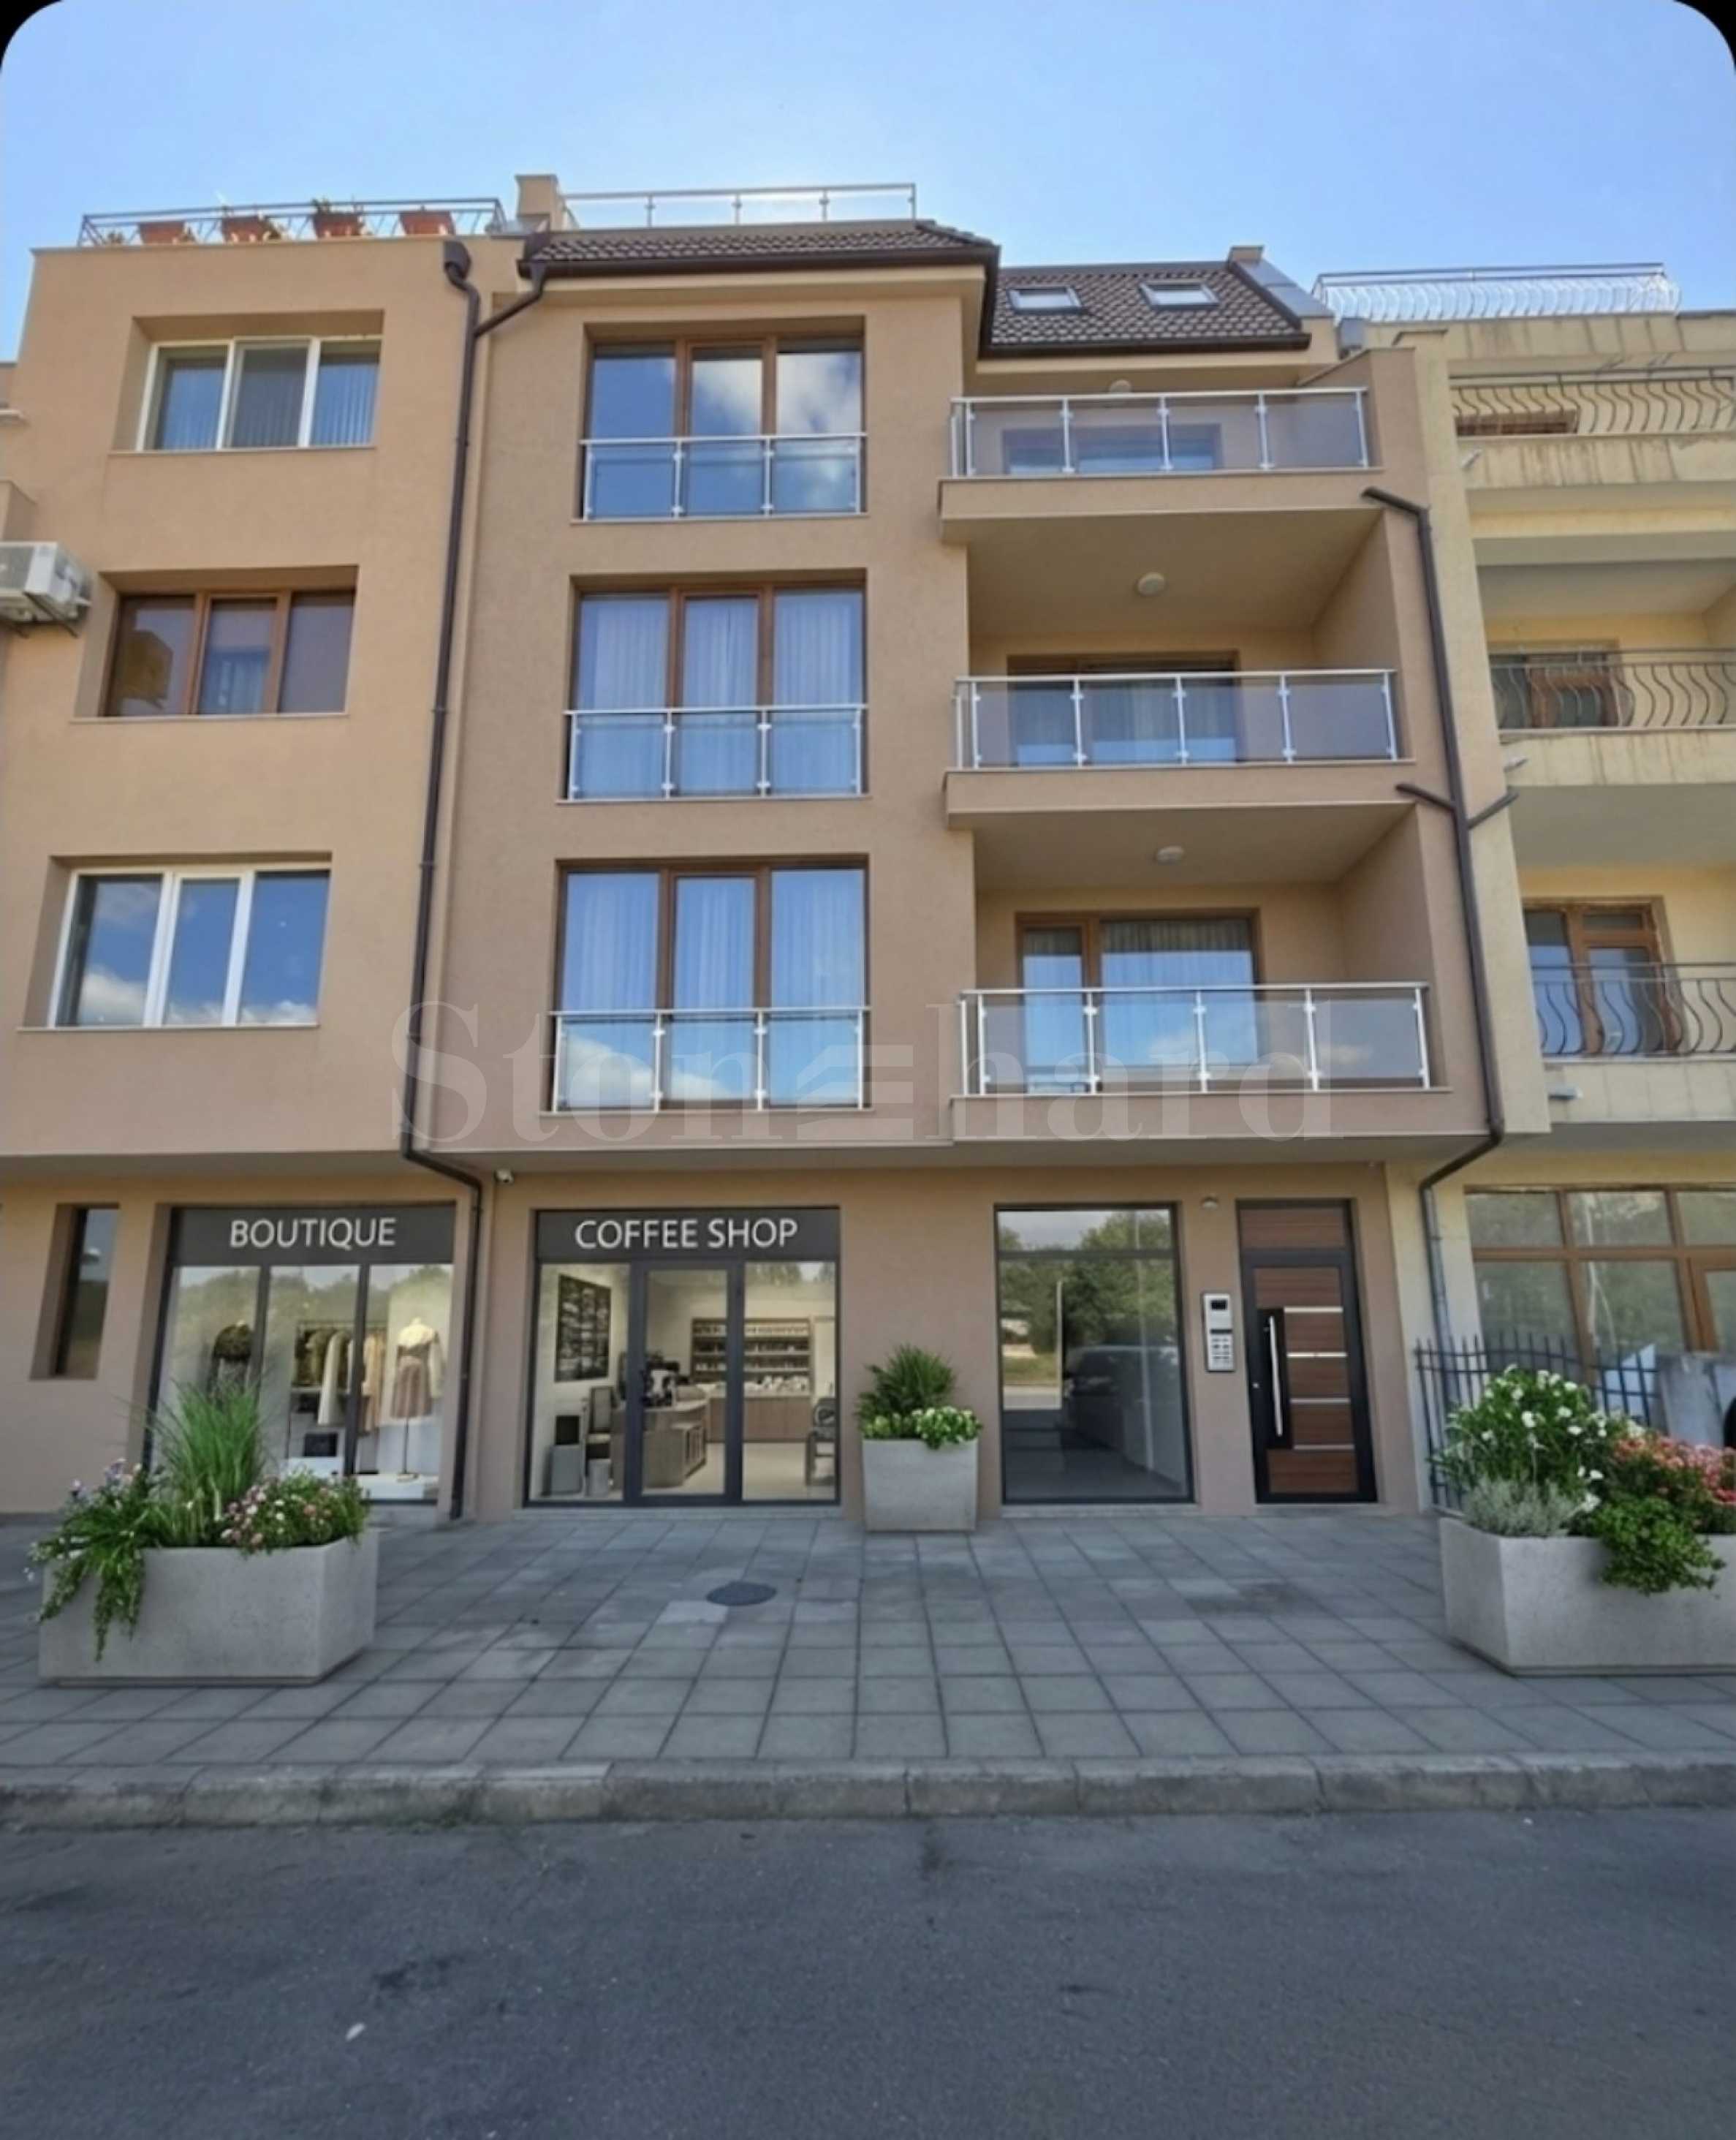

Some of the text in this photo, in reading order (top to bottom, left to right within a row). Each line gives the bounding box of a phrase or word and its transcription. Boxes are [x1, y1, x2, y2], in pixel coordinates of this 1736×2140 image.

[230, 1217, 397, 1249] BOUTIQUE
[575, 1218, 798, 1249] COFFEE SHOP
